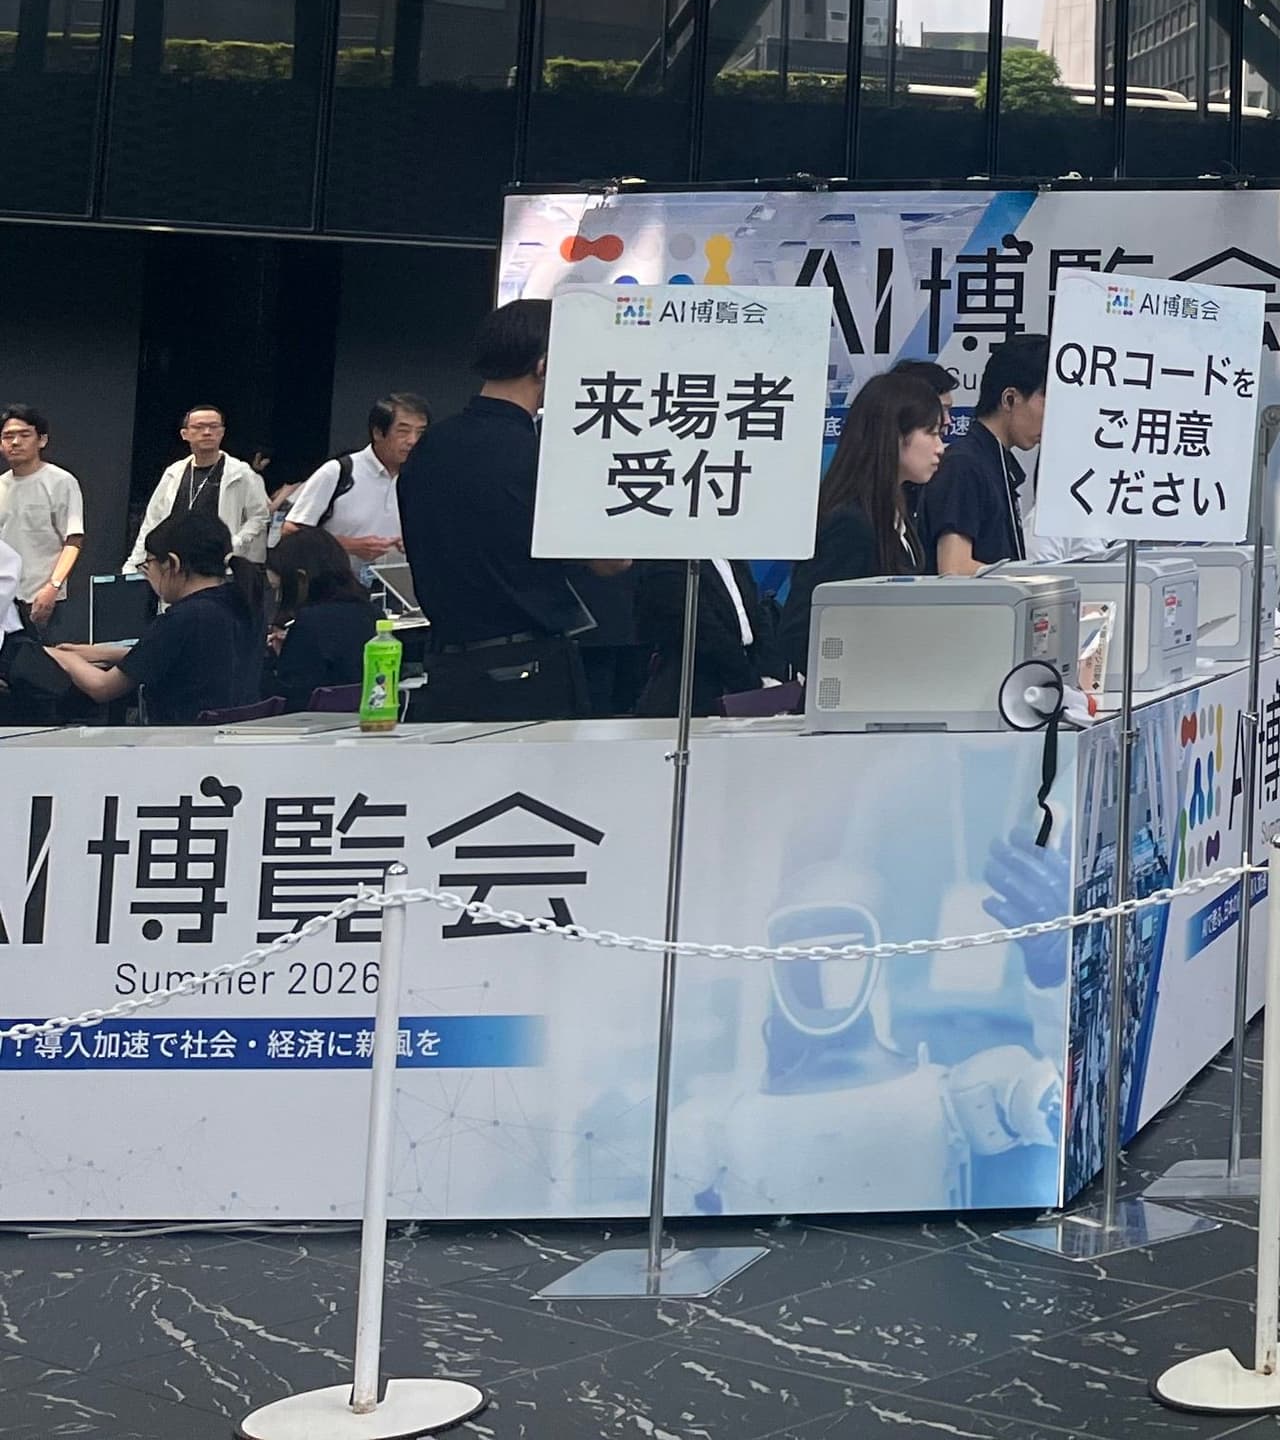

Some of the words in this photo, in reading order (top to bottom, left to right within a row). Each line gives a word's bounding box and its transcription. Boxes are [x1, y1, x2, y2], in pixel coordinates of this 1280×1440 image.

[658, 298, 768, 327] AI博覧会
[1139, 293, 1220, 322] AI博覧会
[1055, 342, 1254, 396] QRコードを
[573, 372, 795, 442] 来場者
[1094, 409, 1213, 457] ご用意
[606, 451, 752, 518] 受付
[1069, 472, 1226, 515] ください
[0, 776, 605, 944] I博覧会
[288, 962, 379, 994] 2026
